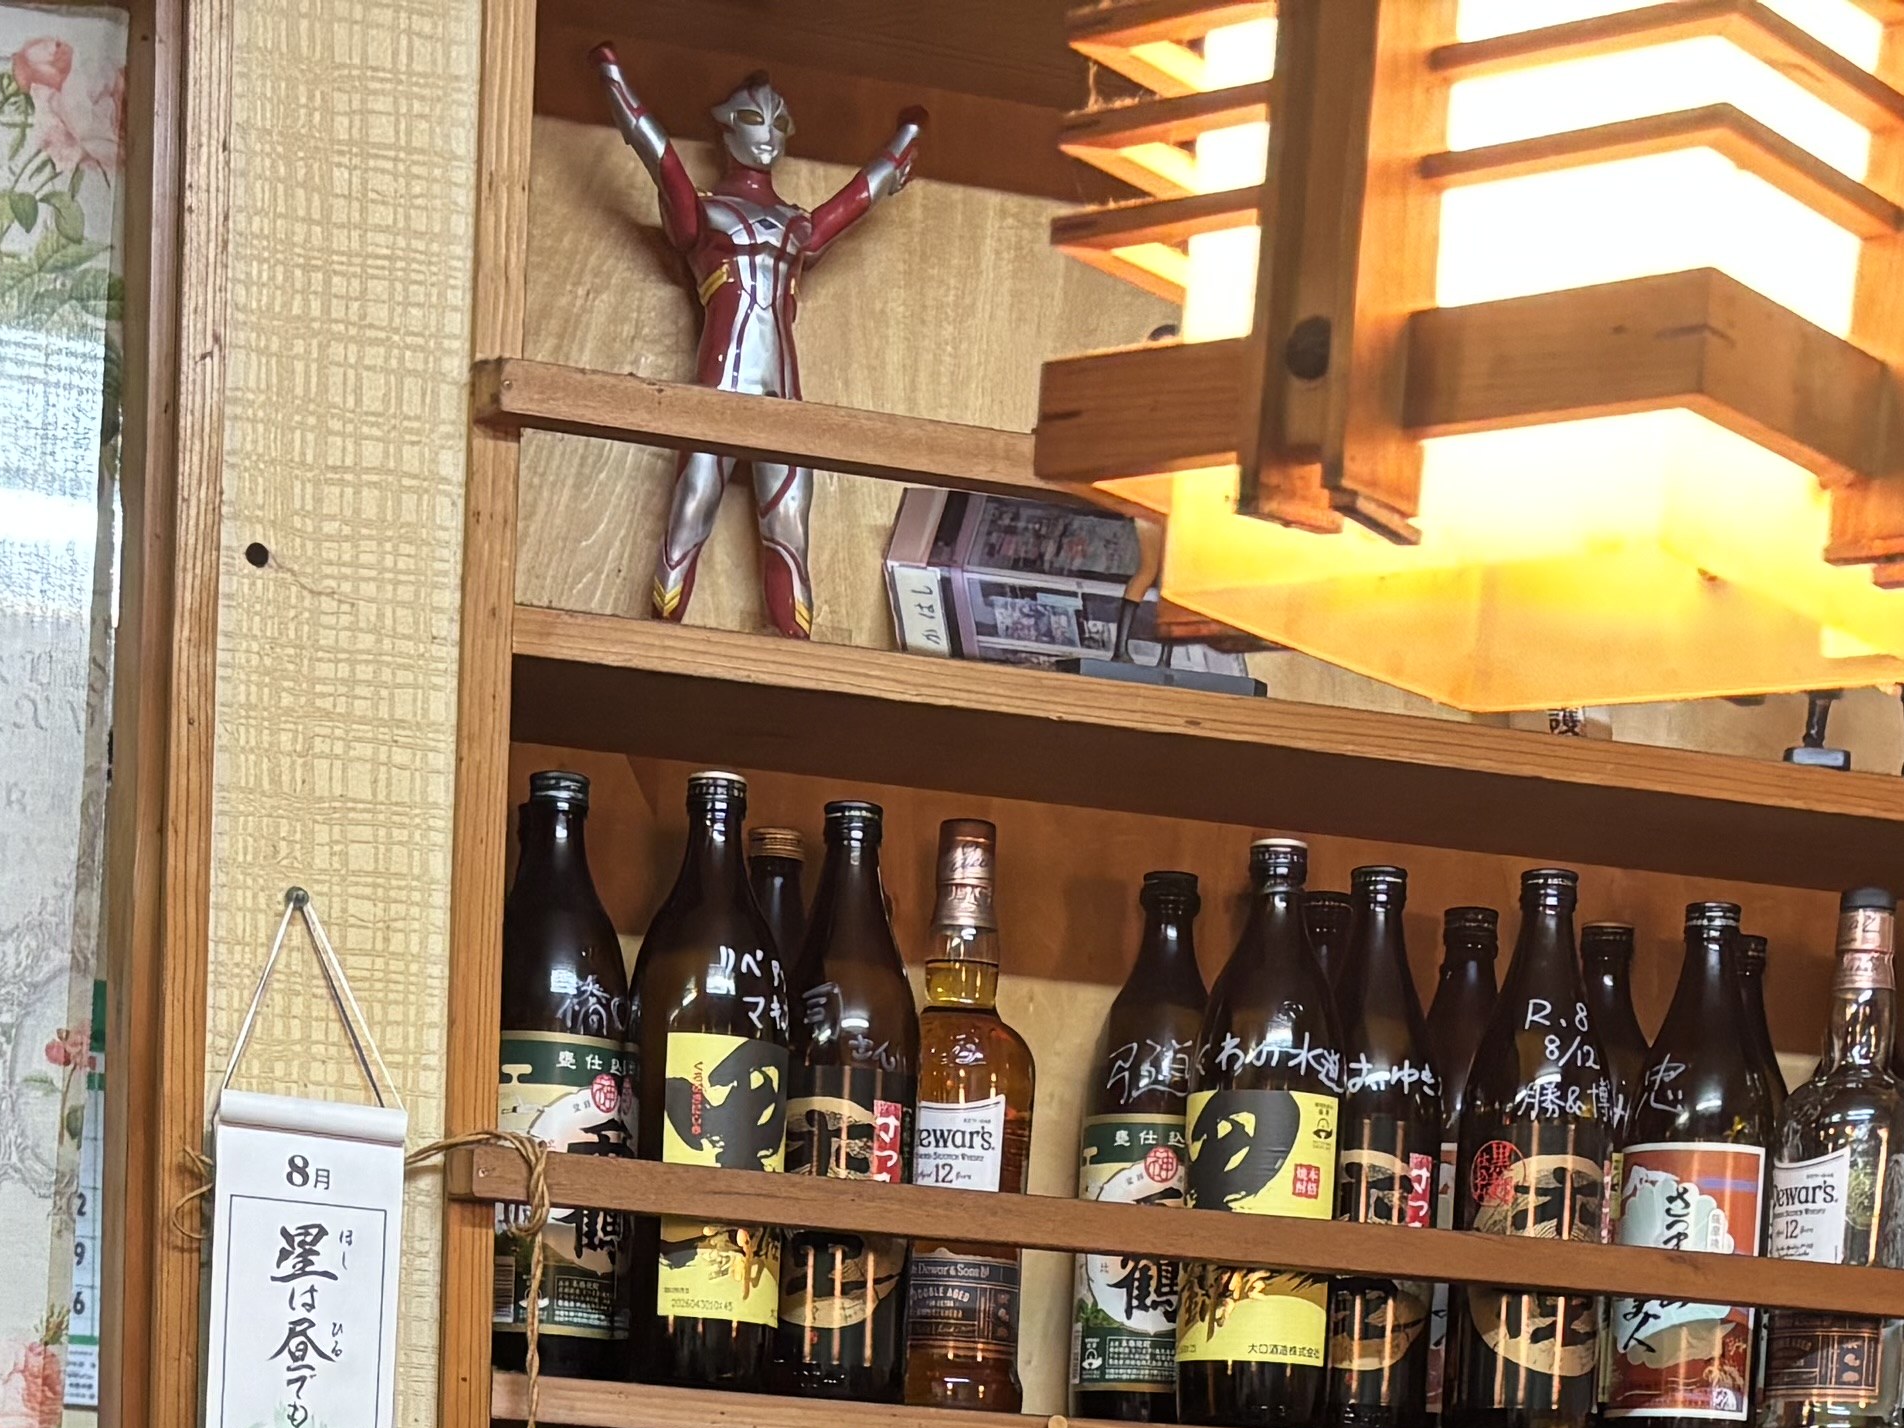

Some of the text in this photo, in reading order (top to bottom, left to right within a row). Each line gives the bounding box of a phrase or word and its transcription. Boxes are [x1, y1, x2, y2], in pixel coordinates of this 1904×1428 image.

[1544, 1034, 1601, 1070] 8/12
[286, 1154, 331, 1190] 8月
[933, 1162, 955, 1184] 12
[1784, 1218, 1799, 1239] 12
